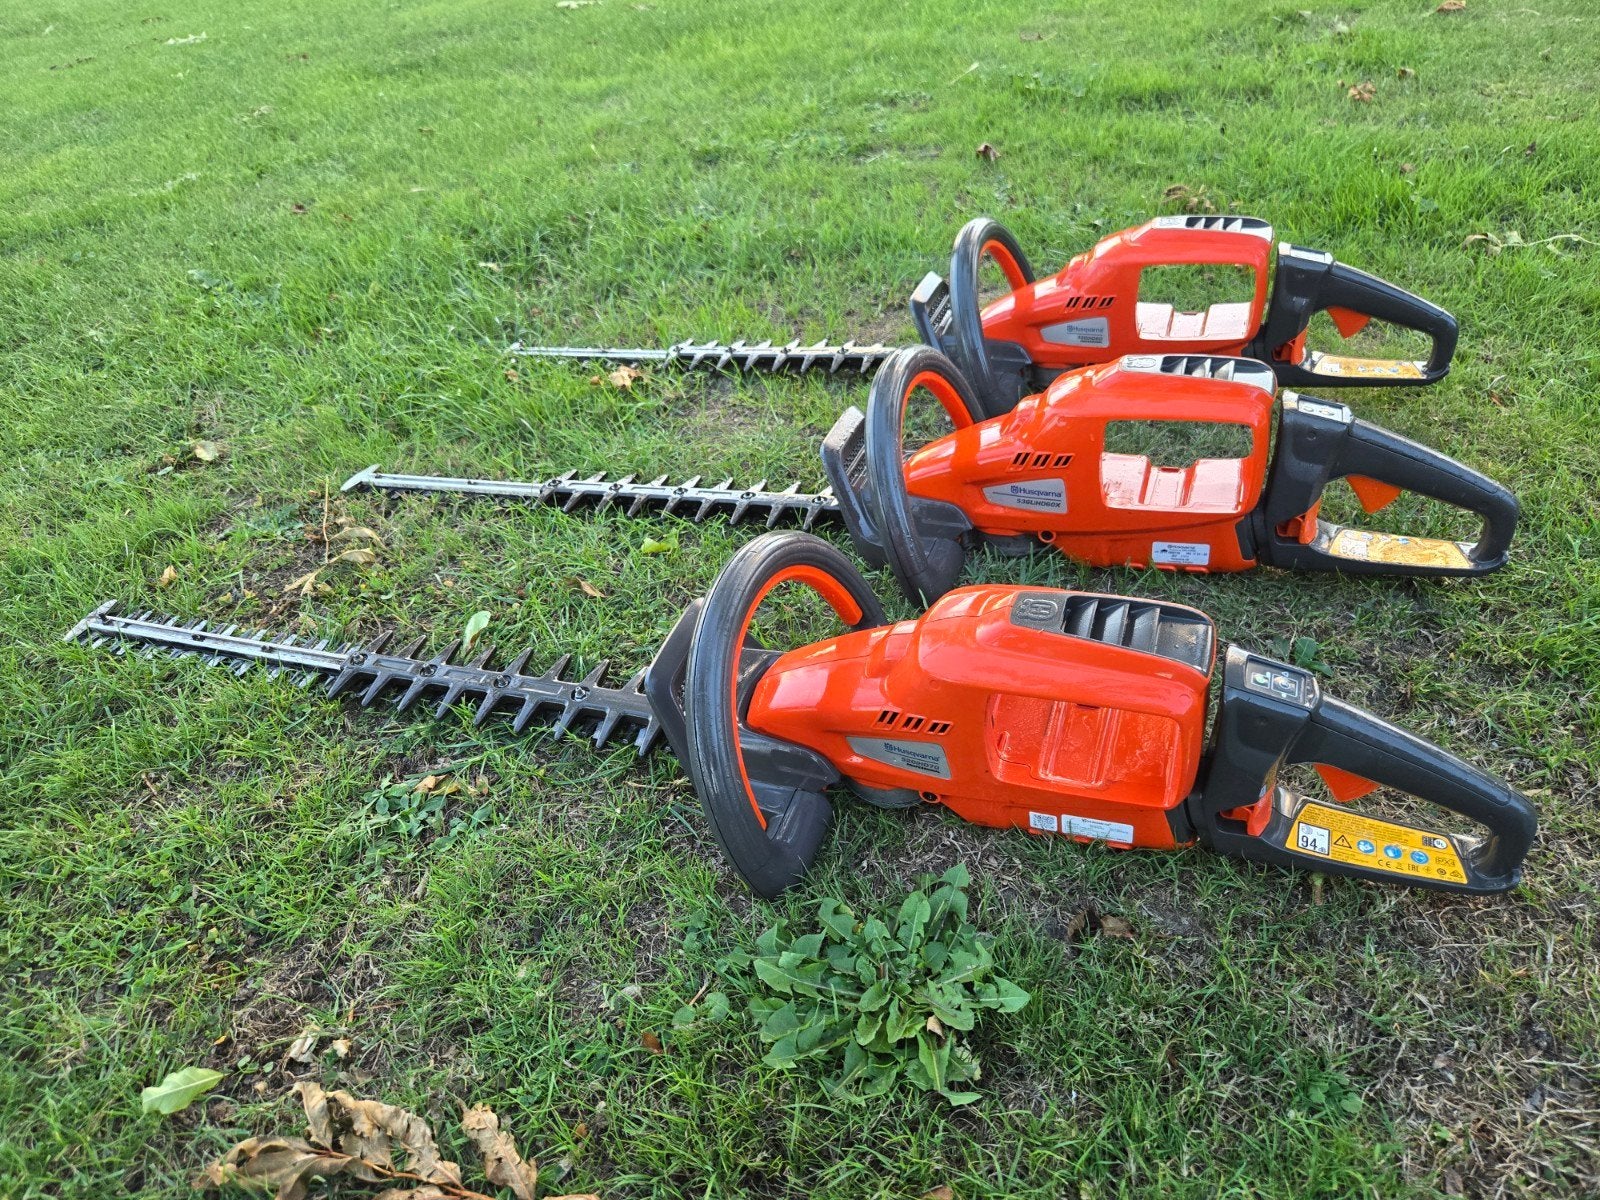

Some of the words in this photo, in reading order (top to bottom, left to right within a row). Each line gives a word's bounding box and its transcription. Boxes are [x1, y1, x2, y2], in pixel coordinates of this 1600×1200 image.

[1019, 487, 1062, 498] Husqvarna
[893, 746, 940, 762] Husqvarna
[1301, 835, 1318, 850] 94
